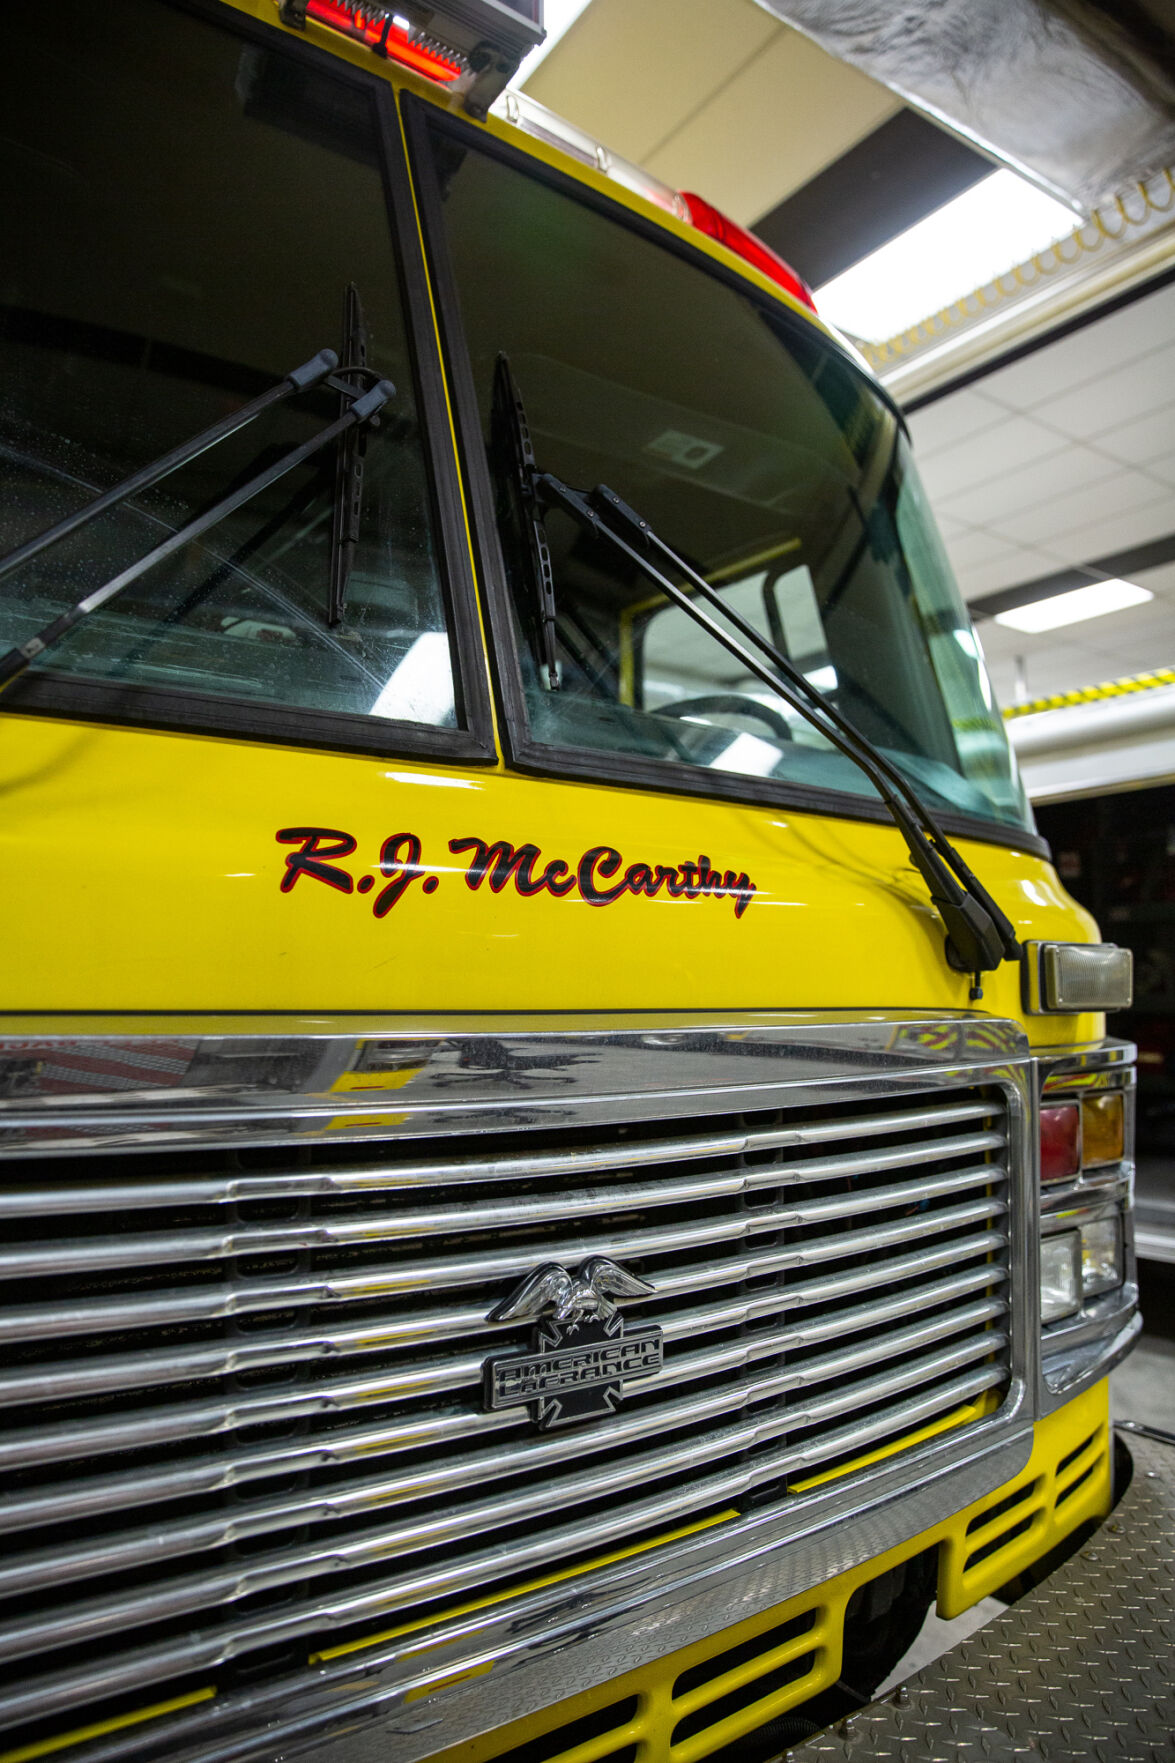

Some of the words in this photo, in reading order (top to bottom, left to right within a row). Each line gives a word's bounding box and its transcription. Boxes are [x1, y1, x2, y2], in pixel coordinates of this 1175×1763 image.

[275, 827, 439, 919] R.J.
[448, 837, 757, 919] McCarthy
[499, 1339, 660, 1381] AMERICAN
